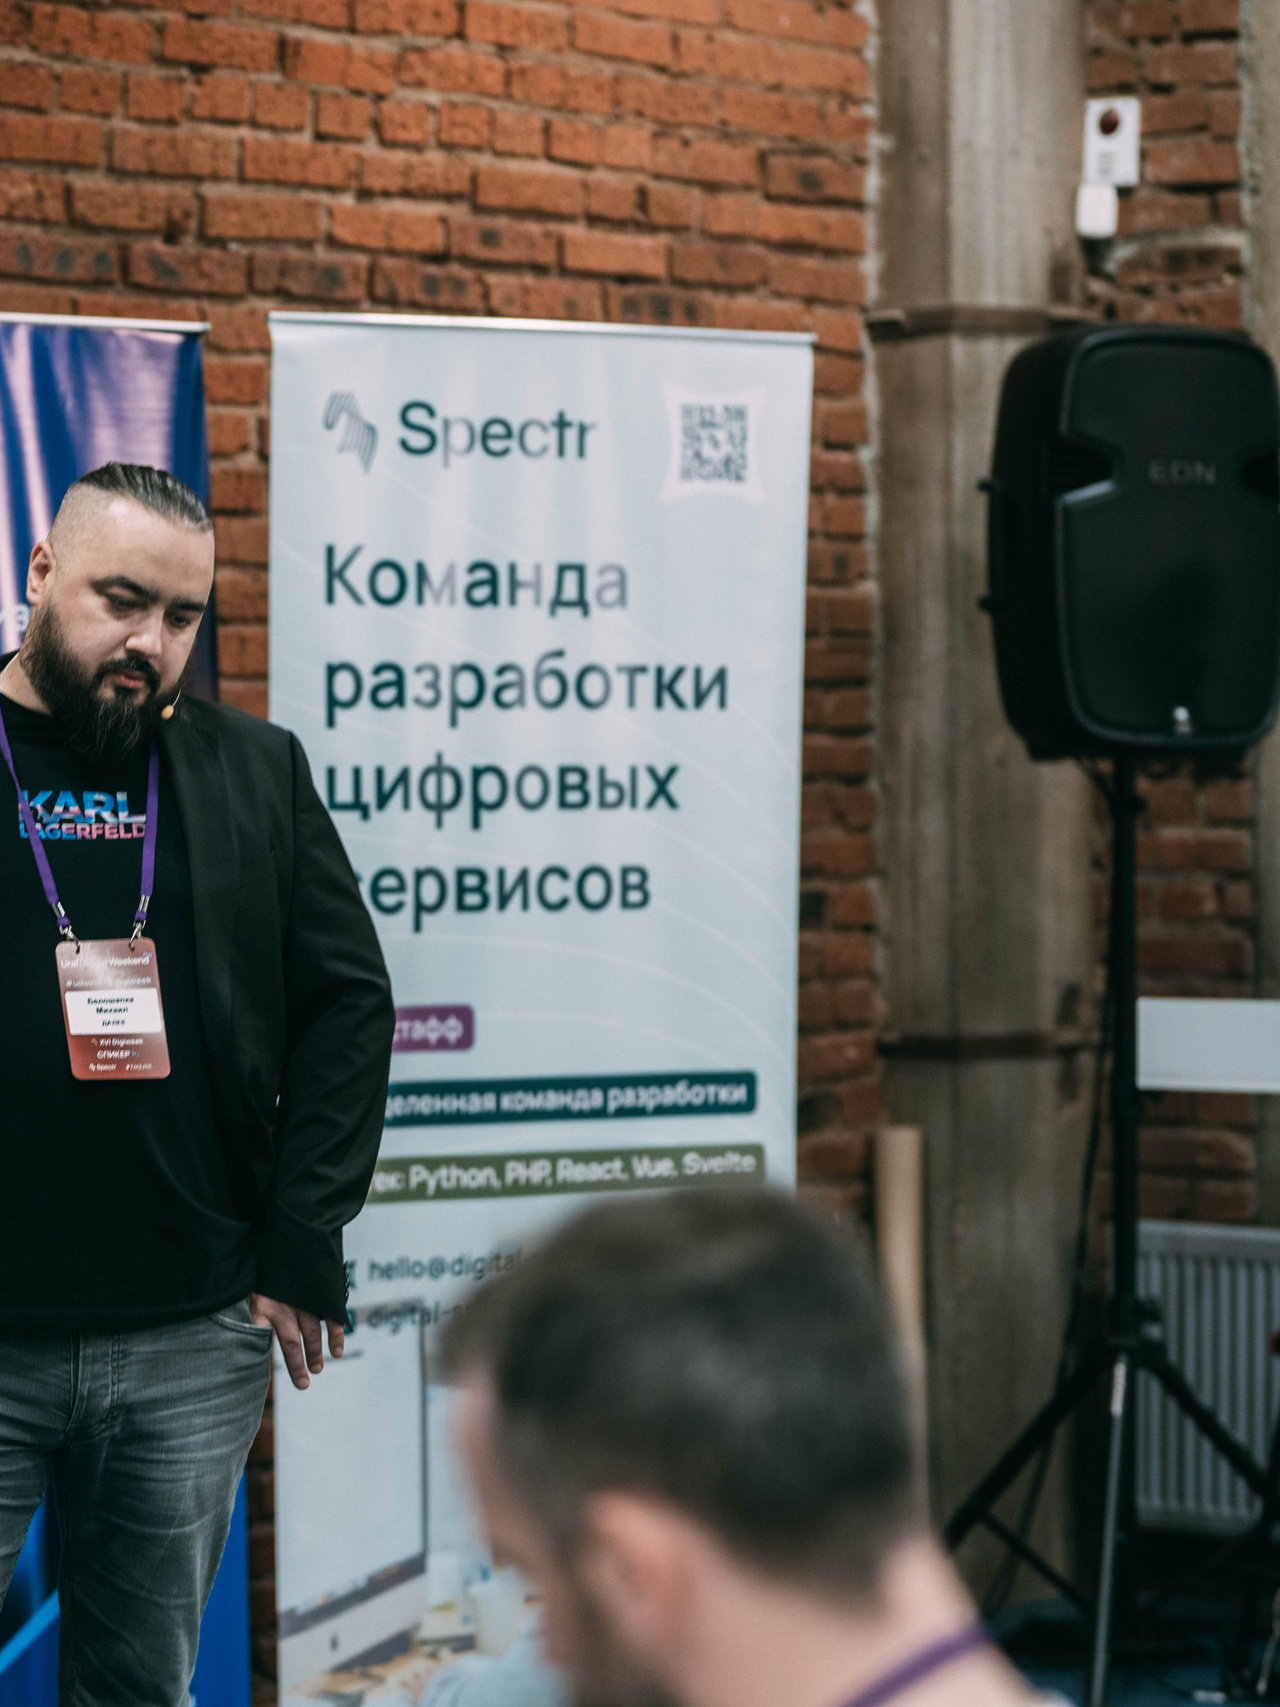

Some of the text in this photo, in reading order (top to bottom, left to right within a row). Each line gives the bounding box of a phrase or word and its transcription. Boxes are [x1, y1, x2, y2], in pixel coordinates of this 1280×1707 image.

[399, 400, 596, 469] Spectr
[325, 544, 628, 618] Команда
[325, 648, 728, 729] разработки
[19, 790, 147, 824] KARL
[325, 751, 681, 831] цифровых
[359, 864, 653, 934] ервисов
[500, 1087, 604, 1114] команда
[607, 1079, 748, 1116] разработки
[408, 1163, 502, 1196] Python,
[504, 1159, 552, 1189] PHP,
[555, 1156, 629, 1184] React,
[631, 1154, 679, 1179] Vue,
[682, 1151, 757, 1176] Svelte
